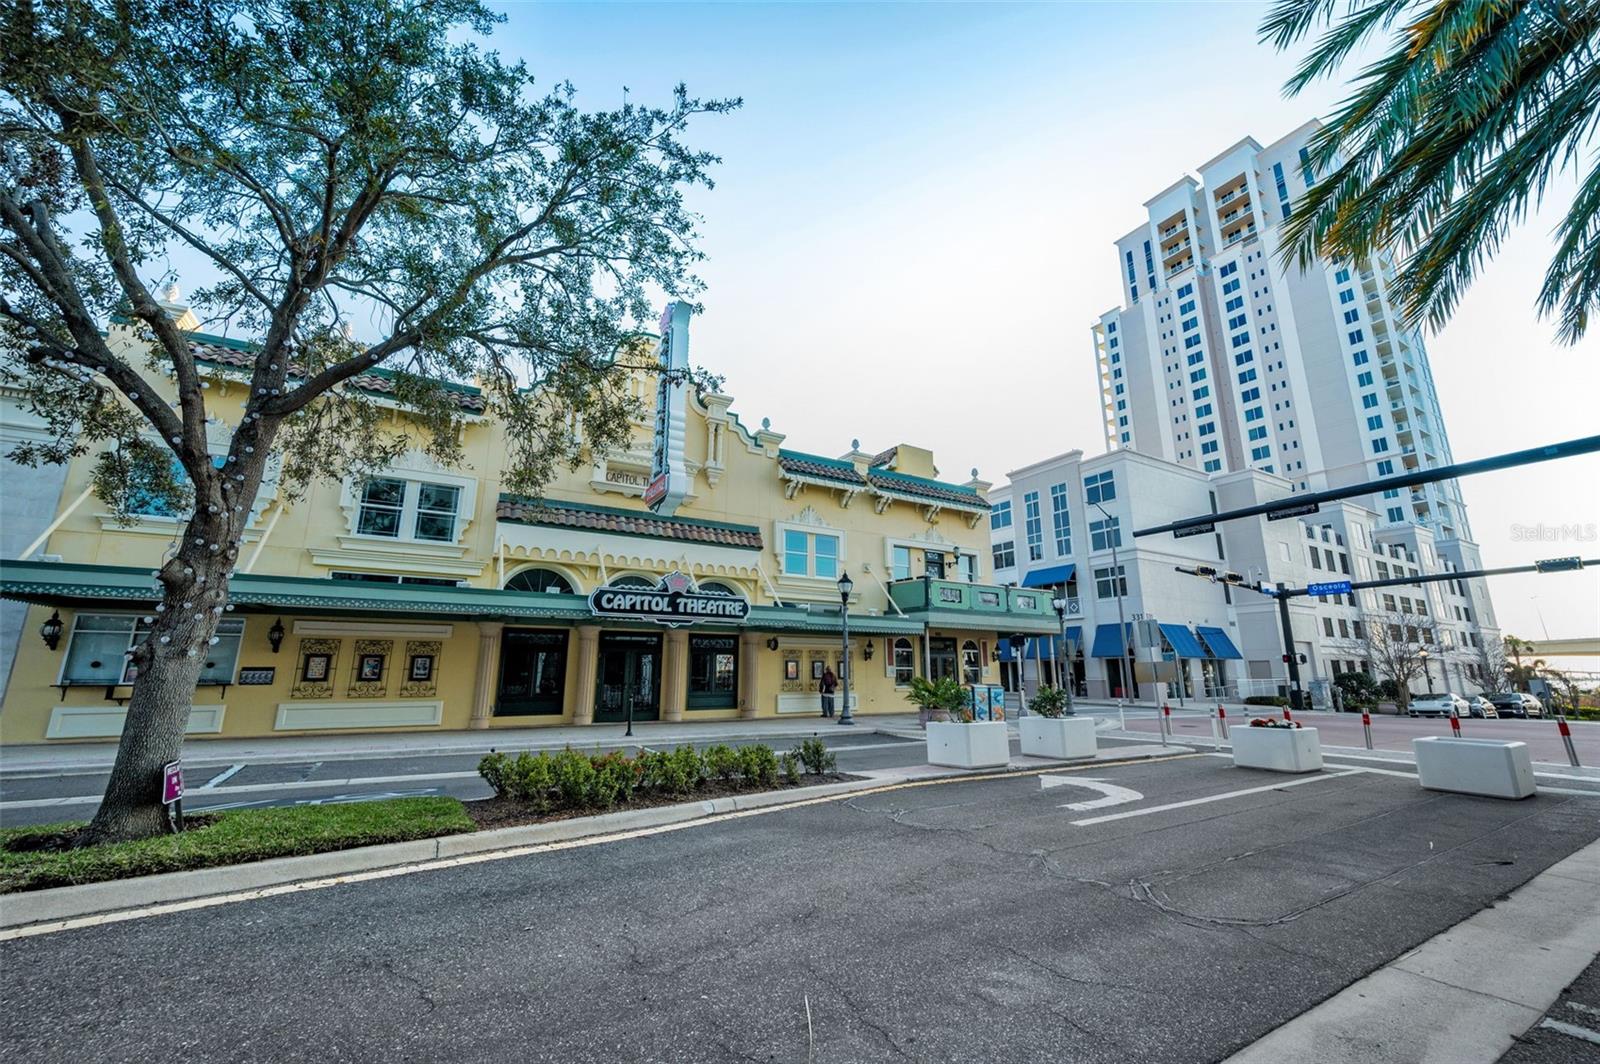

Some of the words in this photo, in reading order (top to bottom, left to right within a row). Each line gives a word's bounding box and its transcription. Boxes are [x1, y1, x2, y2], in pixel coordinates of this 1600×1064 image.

[606, 472, 637, 486] CAPITOL
[601, 594, 672, 612] CAPITOL
[676, 598, 744, 616] THEATRE
